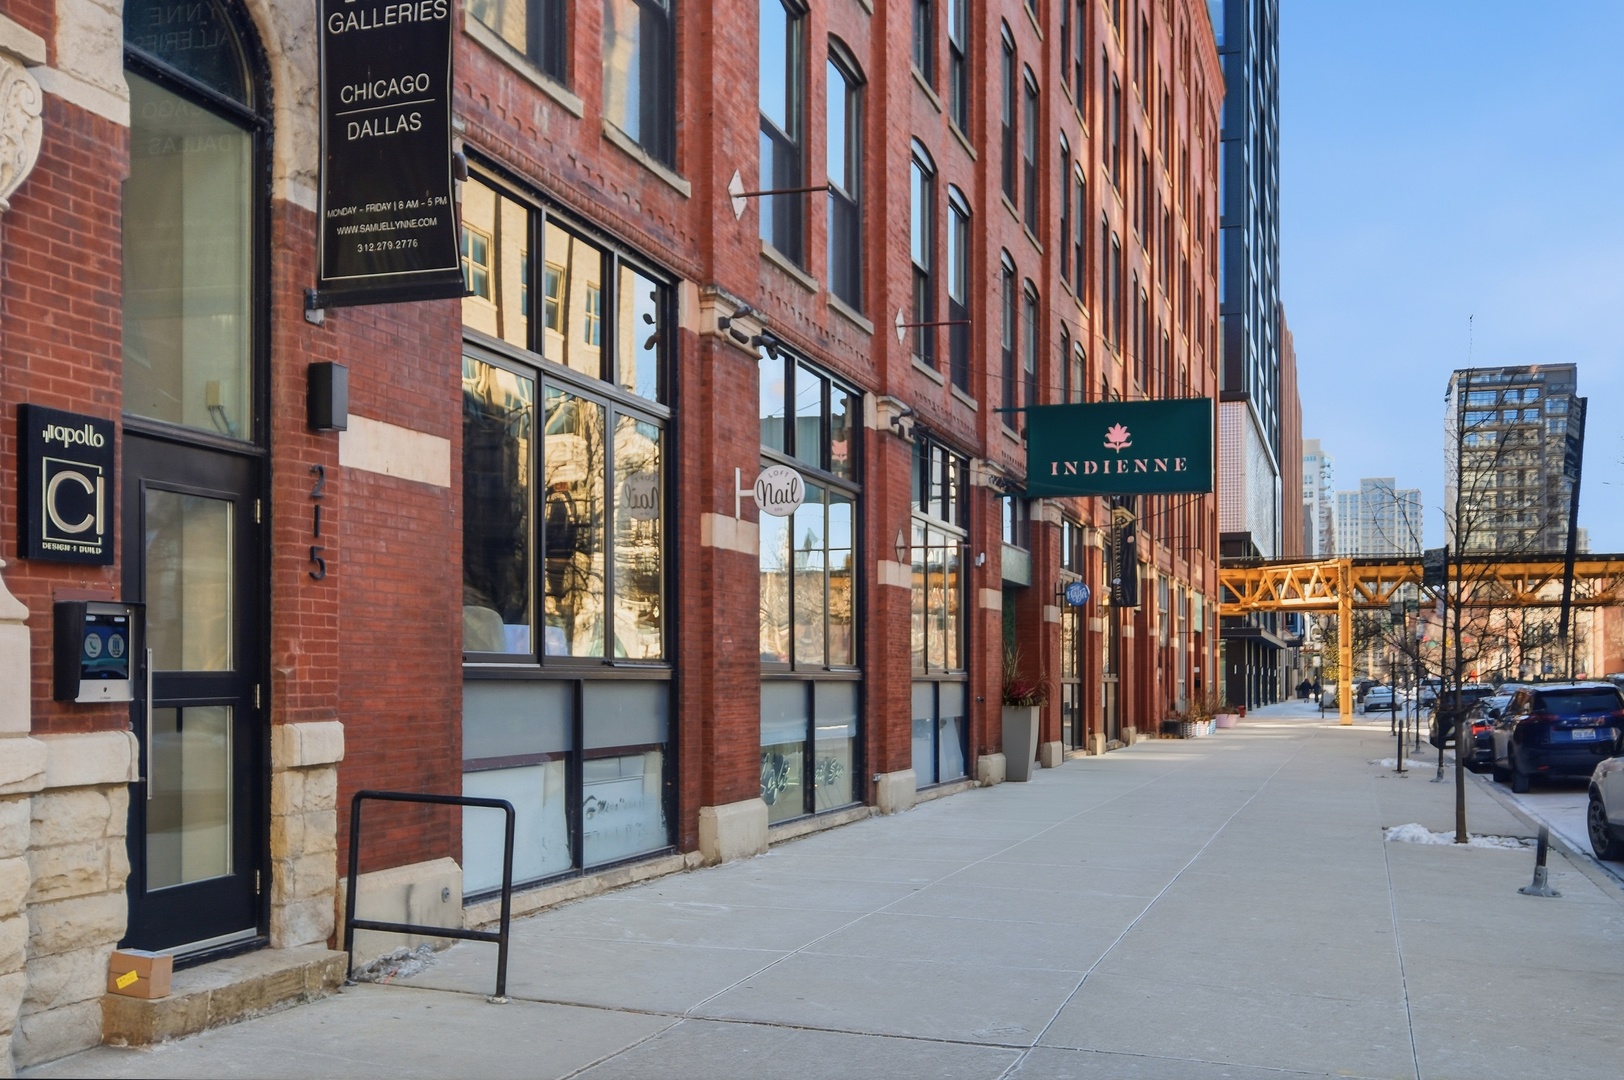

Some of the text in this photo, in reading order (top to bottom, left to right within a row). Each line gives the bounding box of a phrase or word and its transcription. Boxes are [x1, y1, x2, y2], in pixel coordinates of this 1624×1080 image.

[328, 0, 448, 35] GALLERIES
[340, 73, 430, 104] CHICAGO
[347, 112, 422, 141] DALLAS
[327, 206, 357, 218] MONDAY
[365, 201, 392, 213] FRIDAY
[406, 198, 419, 209] AM
[427, 198, 432, 207] 5
[435, 196, 448, 206] PM
[336, 217, 438, 236] WWW.SAMUELLYNNE.COM
[357, 238, 419, 253] 312.279.2776
[54, 423, 105, 448] apollo
[767, 470, 790, 478] LOFT
[1051, 457, 1188, 476] INDIENNE
[756, 477, 800, 507] Nail
[308, 464, 327, 580] 215
[42, 541, 71, 552] DESIGN
